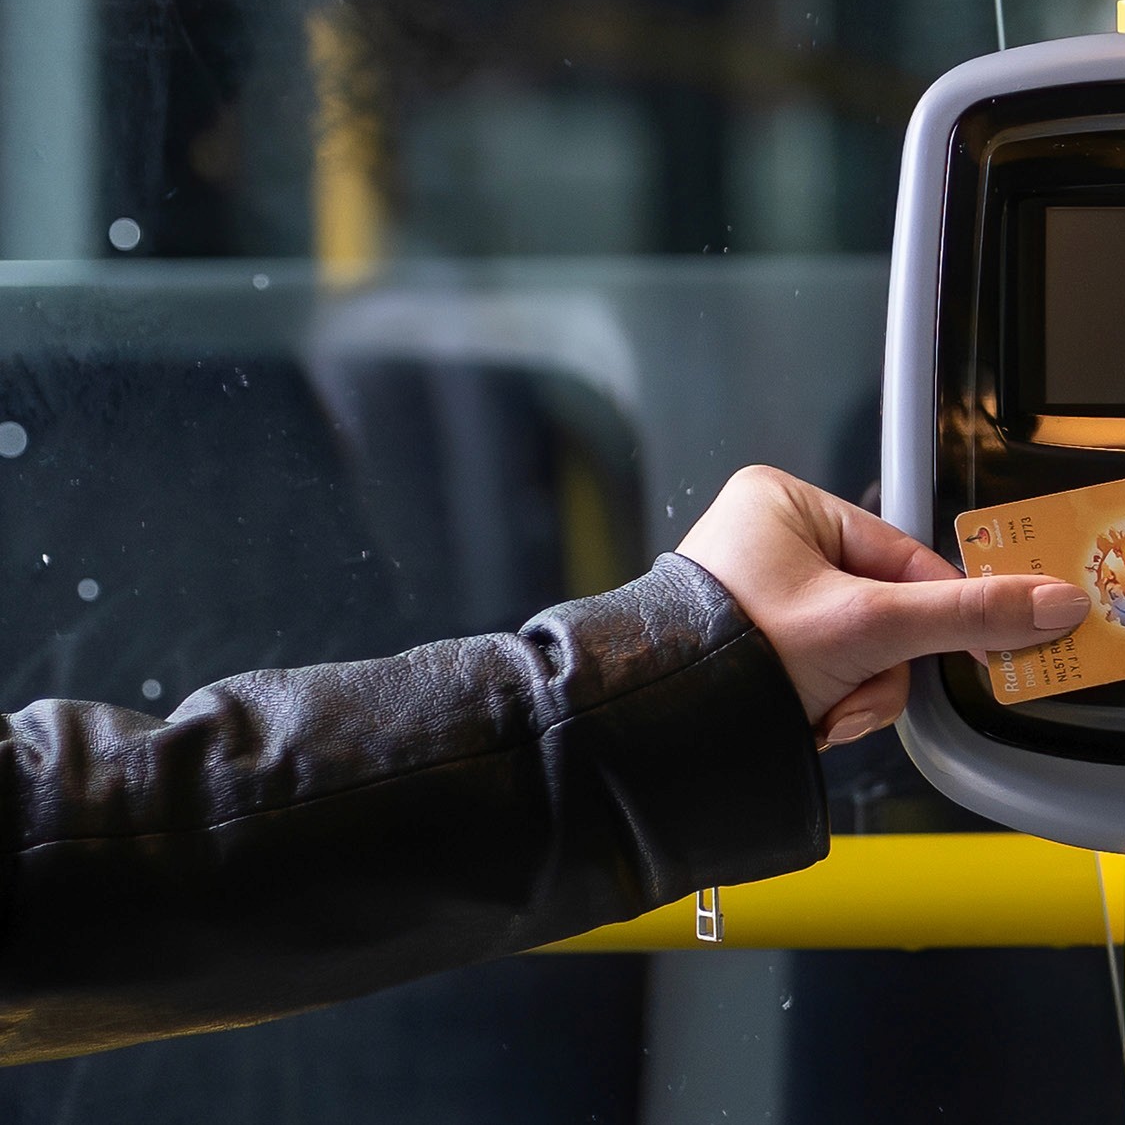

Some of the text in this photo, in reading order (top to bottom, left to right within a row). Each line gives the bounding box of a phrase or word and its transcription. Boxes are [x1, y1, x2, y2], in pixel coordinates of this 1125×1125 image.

[1021, 516, 1036, 542] 7773
[1000, 651, 1020, 692] Rabo
[1023, 660, 1037, 688] Debit
[1053, 658, 1068, 683] NL57
